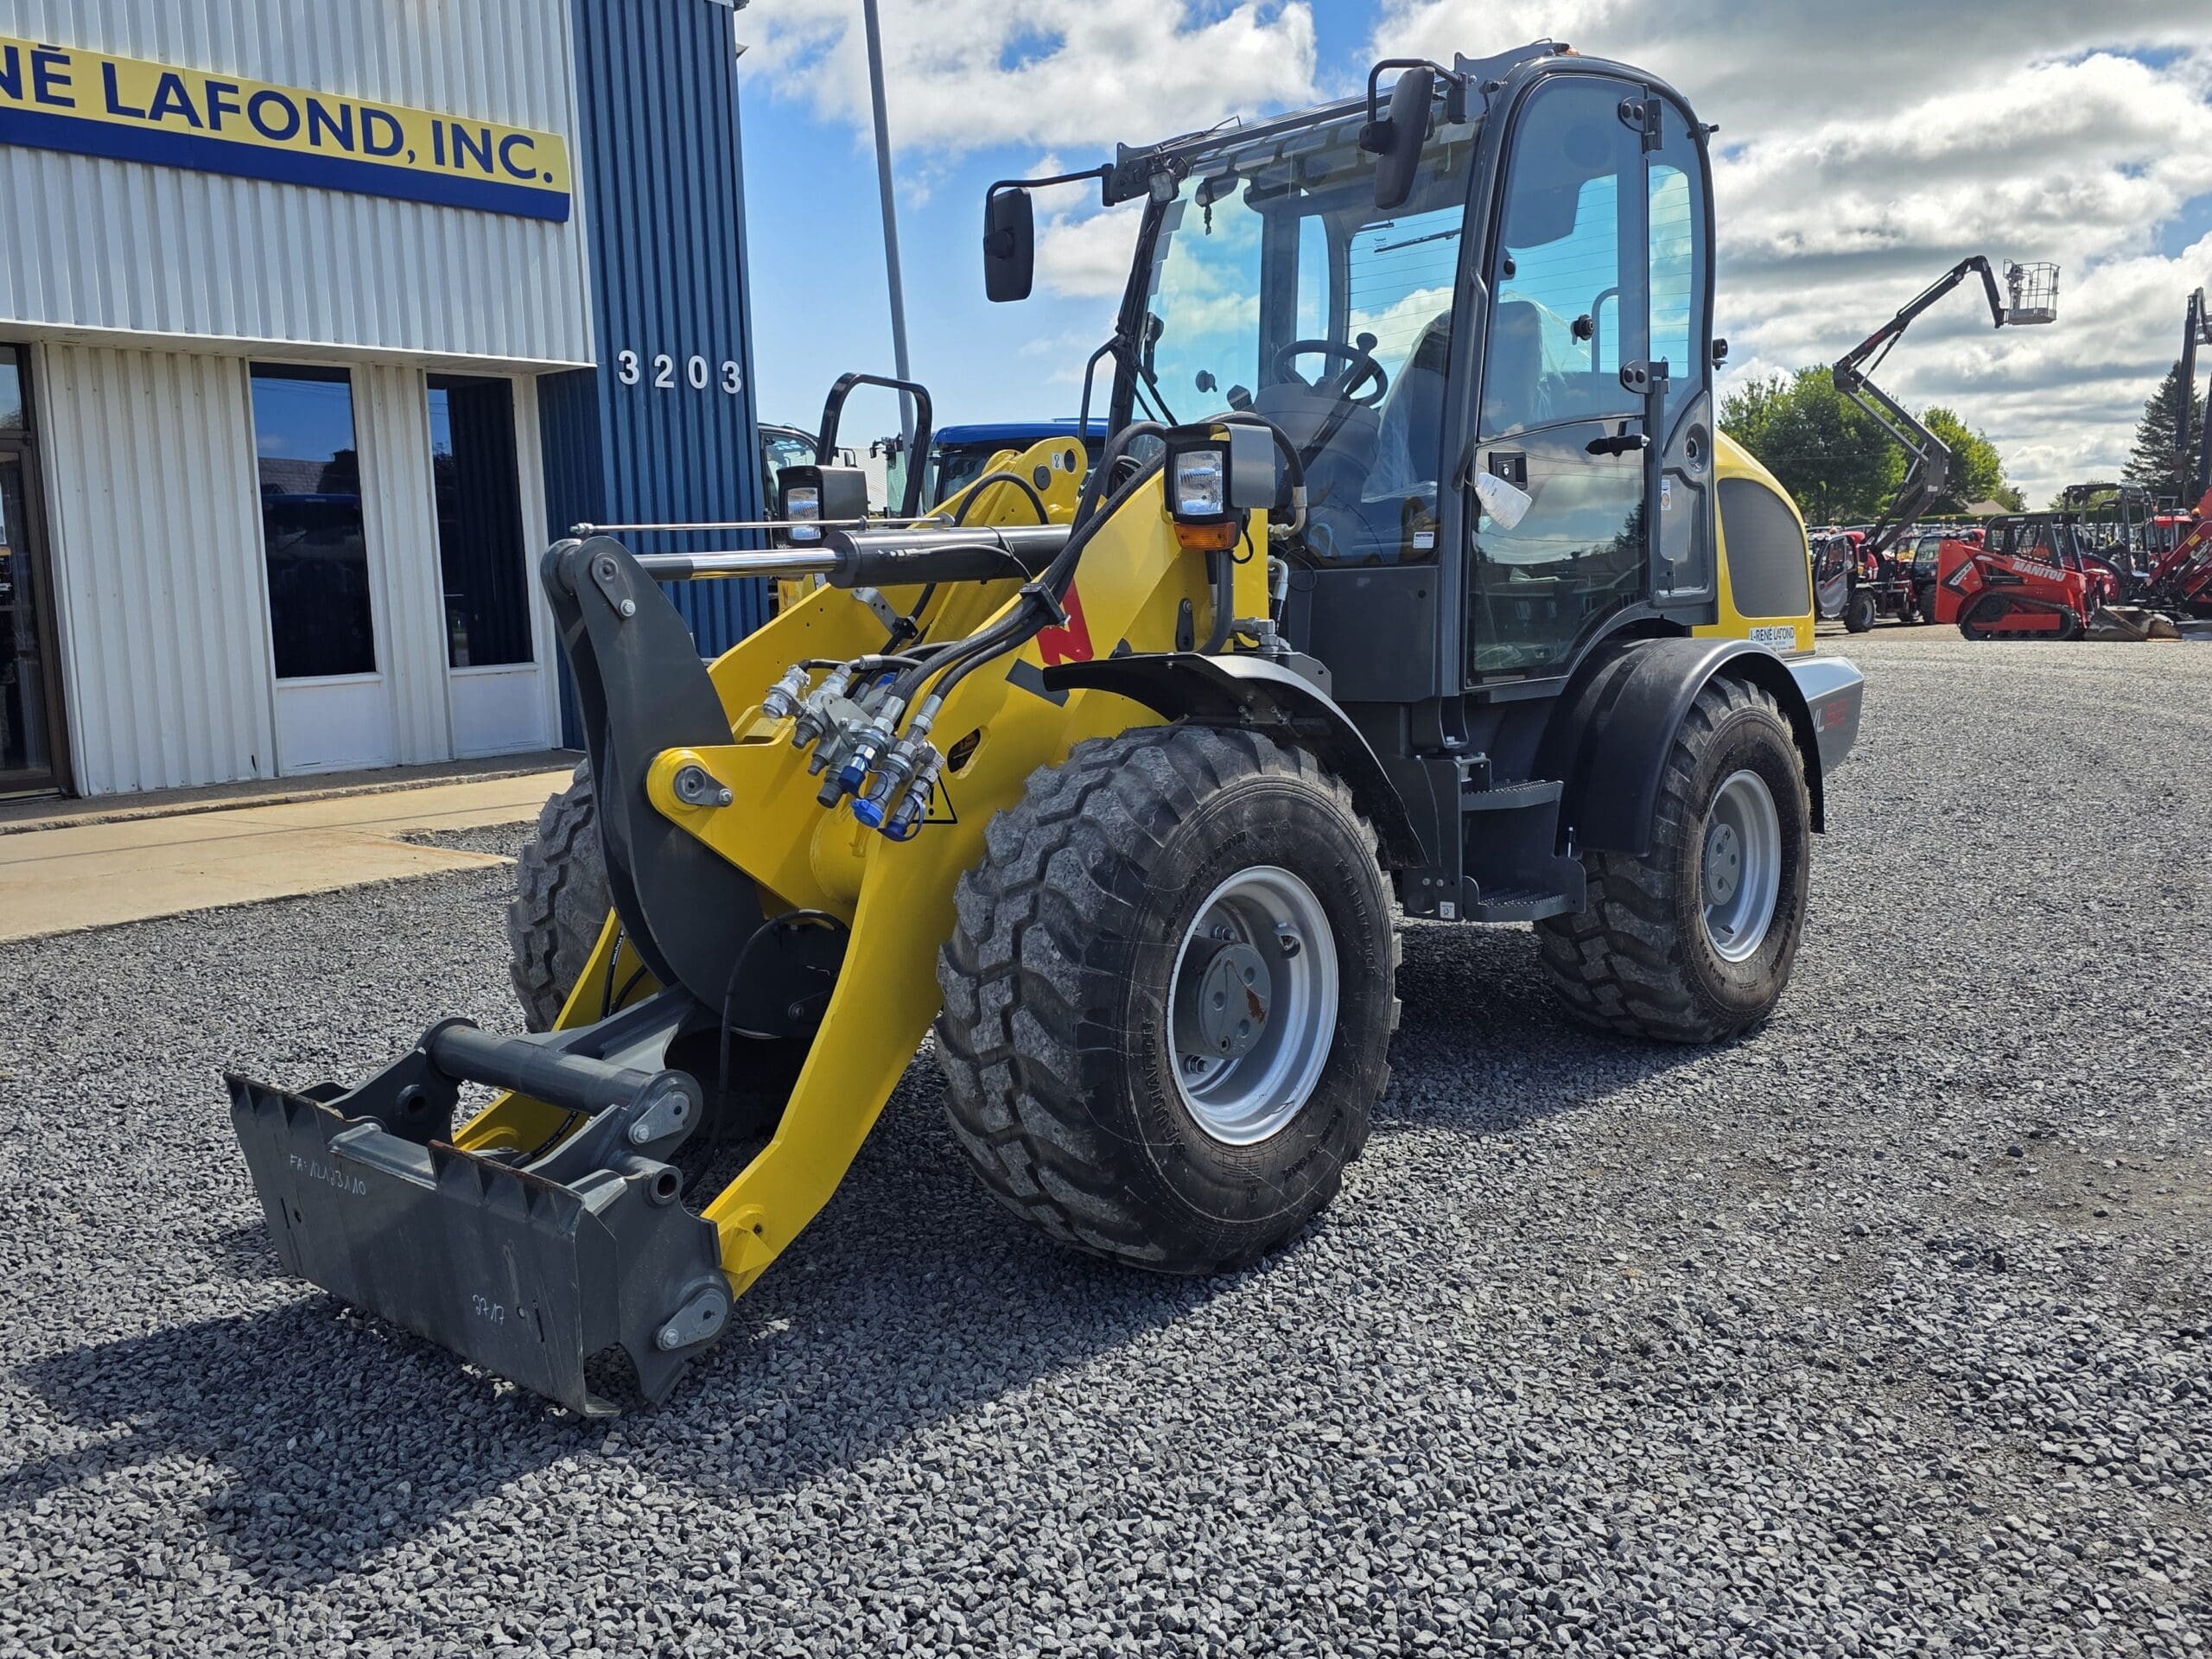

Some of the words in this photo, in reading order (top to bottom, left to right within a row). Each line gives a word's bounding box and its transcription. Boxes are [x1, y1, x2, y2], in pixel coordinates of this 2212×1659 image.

[102, 61, 416, 164] LAFOND,
[432, 119, 553, 184] INC.
[618, 349, 742, 394] 3203
[2012, 561, 2067, 582] MANITOU
[289, 1154, 308, 1173] FA:
